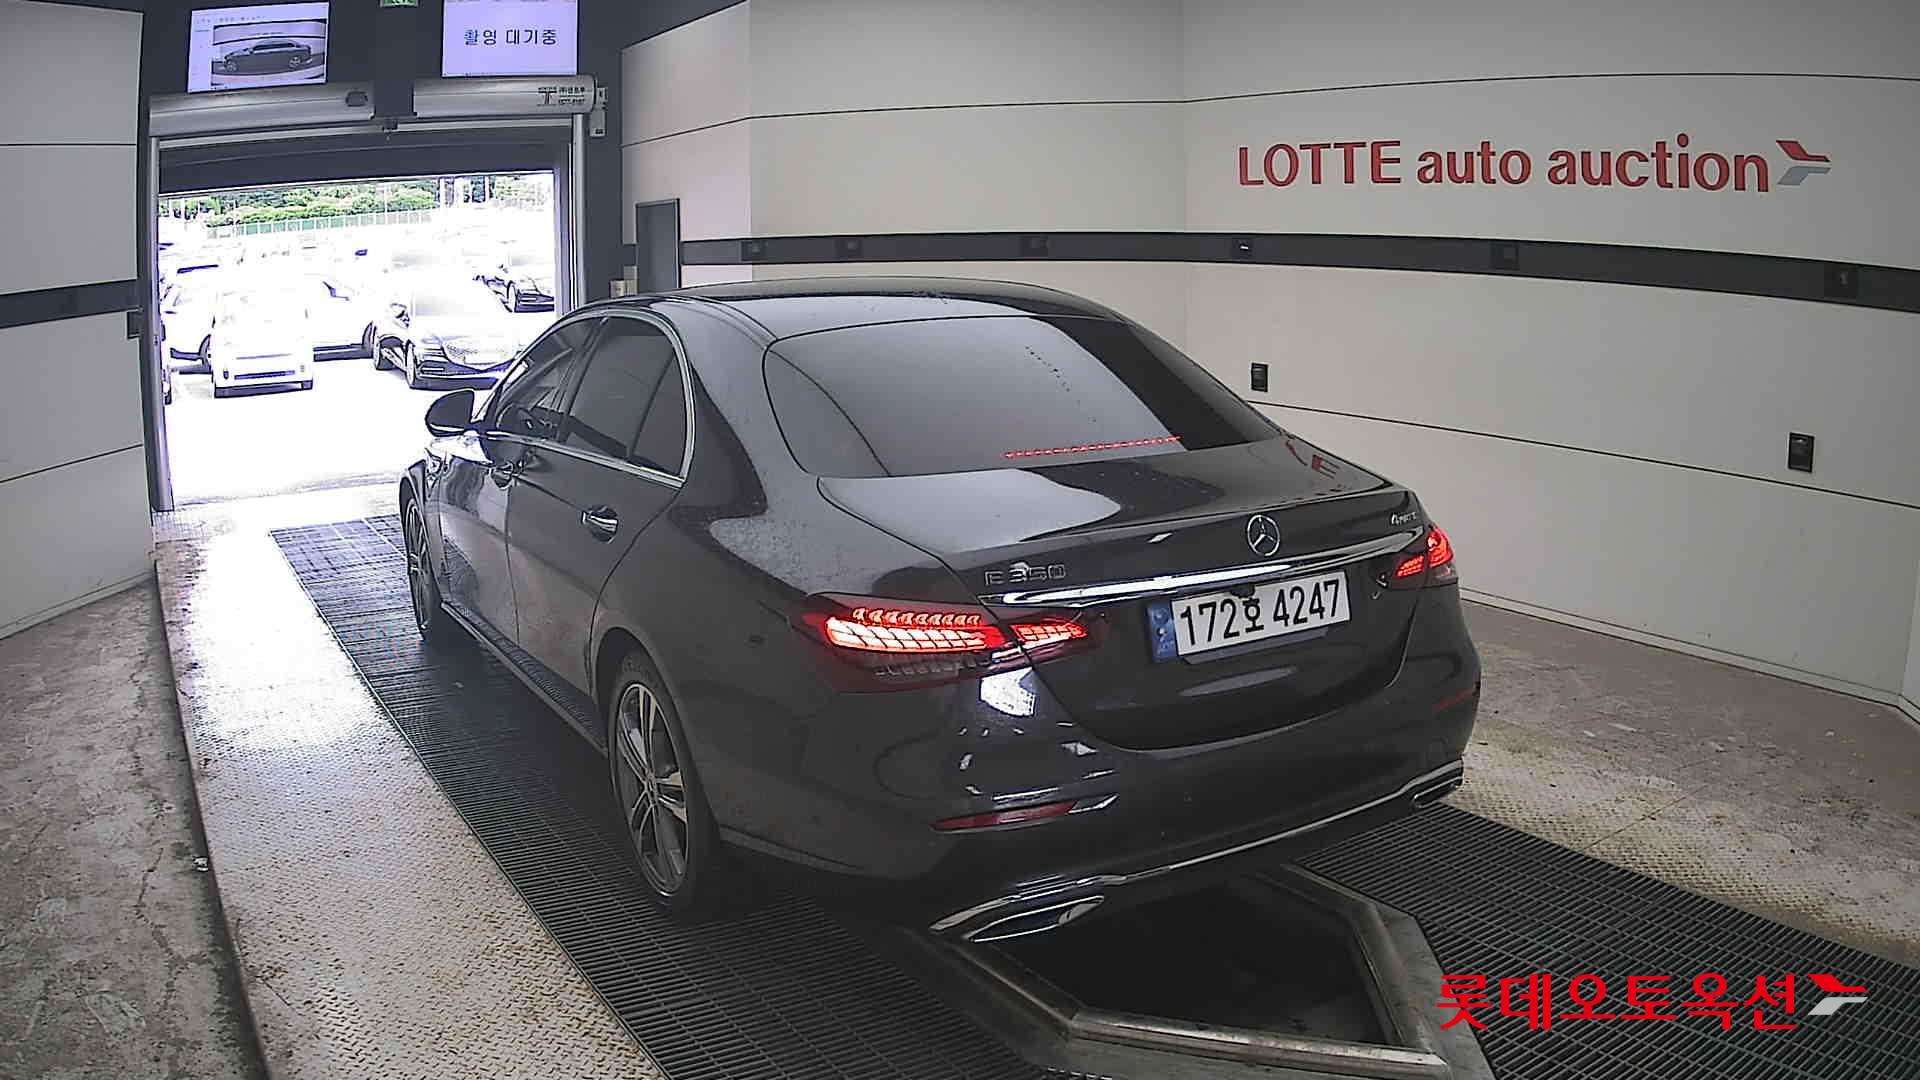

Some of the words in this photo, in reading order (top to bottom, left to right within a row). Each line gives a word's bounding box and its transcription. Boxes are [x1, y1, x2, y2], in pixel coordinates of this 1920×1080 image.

[464, 29, 497, 46] 촬영
[505, 29, 557, 46] 대기중
[1239, 141, 1400, 187] LOTTE
[1417, 142, 1531, 186] auto
[1548, 133, 1769, 192] auction
[1008, 561, 1066, 583] 350
[1273, 579, 1340, 627] 4247
